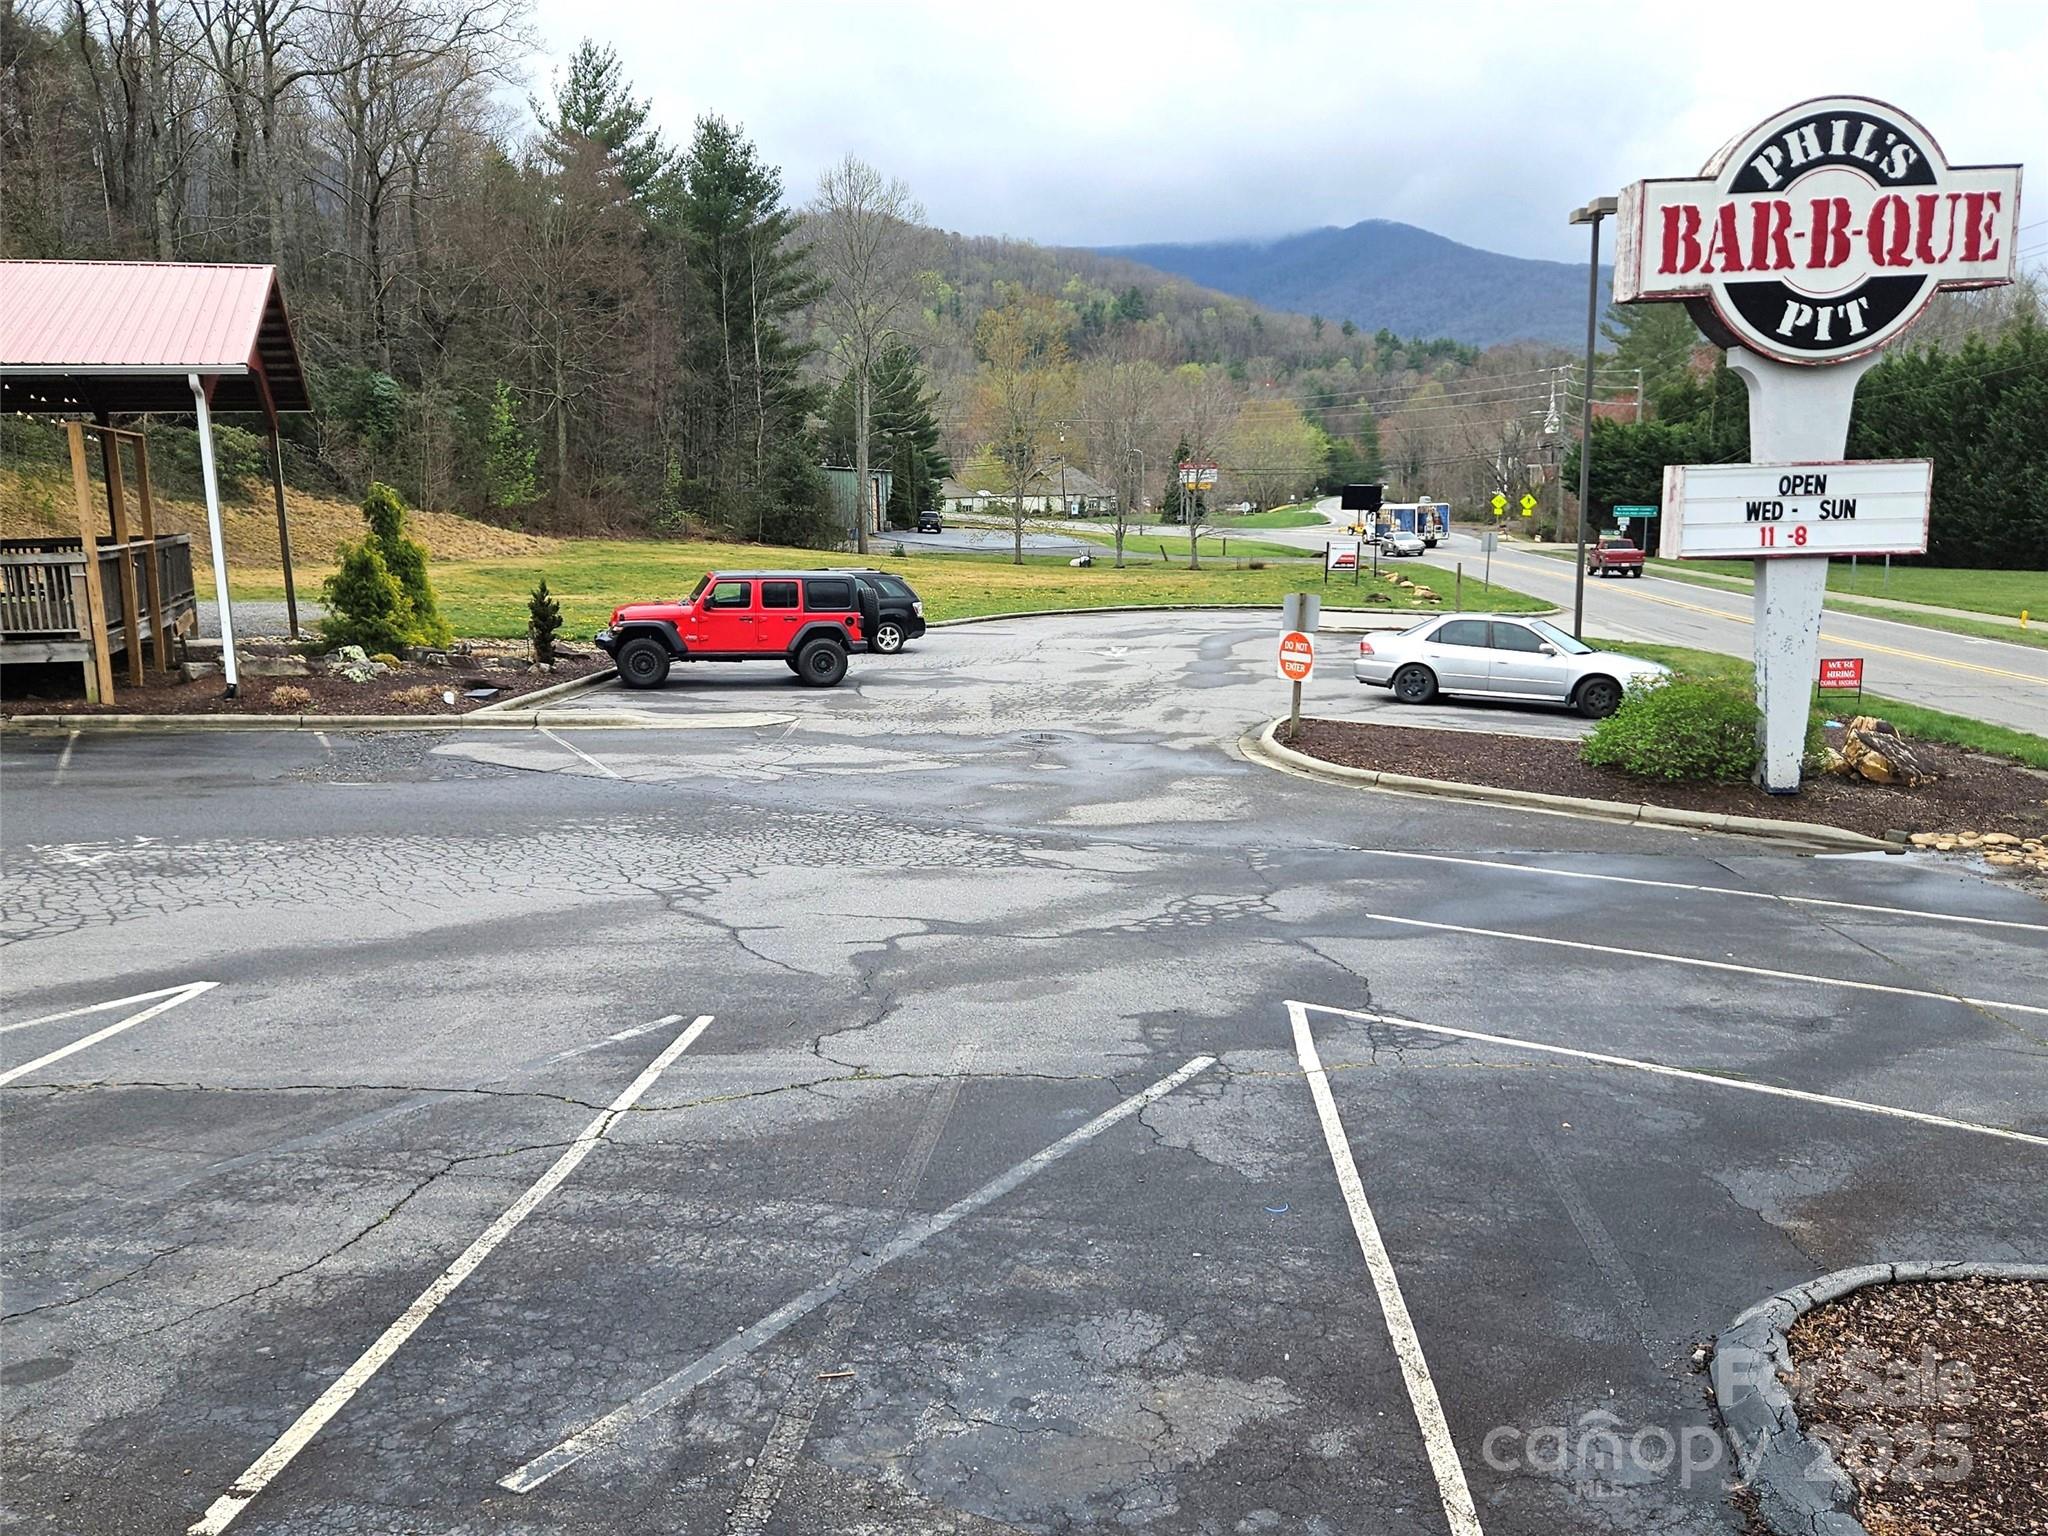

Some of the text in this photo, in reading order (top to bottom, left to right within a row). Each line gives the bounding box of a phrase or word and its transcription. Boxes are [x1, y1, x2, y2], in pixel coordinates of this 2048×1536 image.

[1750, 119, 1918, 188] PHIL'S
[1658, 191, 2001, 274] BAR-B-QUE
[1776, 297, 1870, 341] PIT
[1778, 474, 1827, 496] OPEN
[1745, 501, 1784, 521] WED
[1818, 498, 1857, 520] SUN
[1760, 526, 1775, 546] 11
[1284, 640, 1309, 652] DO NOT
[1285, 661, 1306, 672] ENTER
[1826, 669, 1857, 679] HIRING
